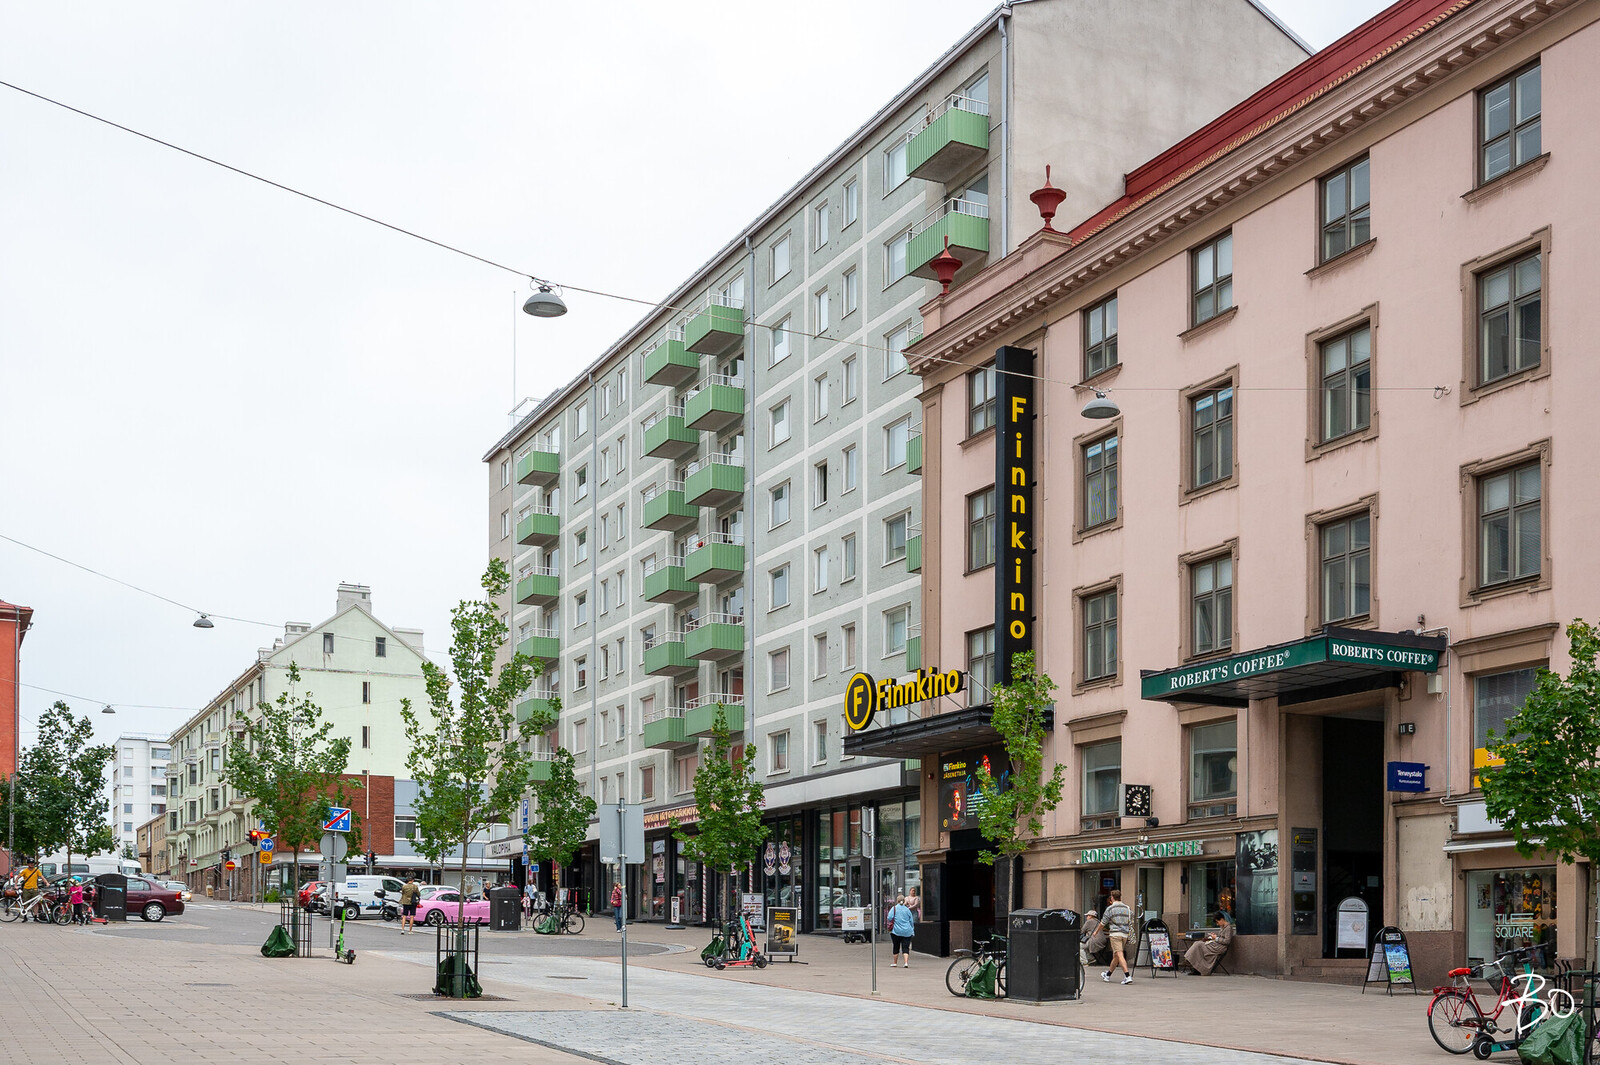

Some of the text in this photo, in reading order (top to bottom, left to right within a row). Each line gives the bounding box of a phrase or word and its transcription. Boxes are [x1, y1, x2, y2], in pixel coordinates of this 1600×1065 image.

[1010, 396, 1026, 639] Finnkino
[1332, 643, 1384, 660] ROBERT'S
[1170, 665, 1228, 689] ROBERT'S
[876, 666, 962, 711] Finnkino
[1408, 724, 1413, 733] E
[948, 761, 966, 770] Finnkino
[1397, 769, 1422, 779] Terveystalo
[491, 842, 511, 856] VALOPIHA
[1081, 840, 1201, 864] ROBERT'S COFFEE
[1496, 912, 1534, 925] TILE
[1496, 926, 1534, 938] SQUARE
